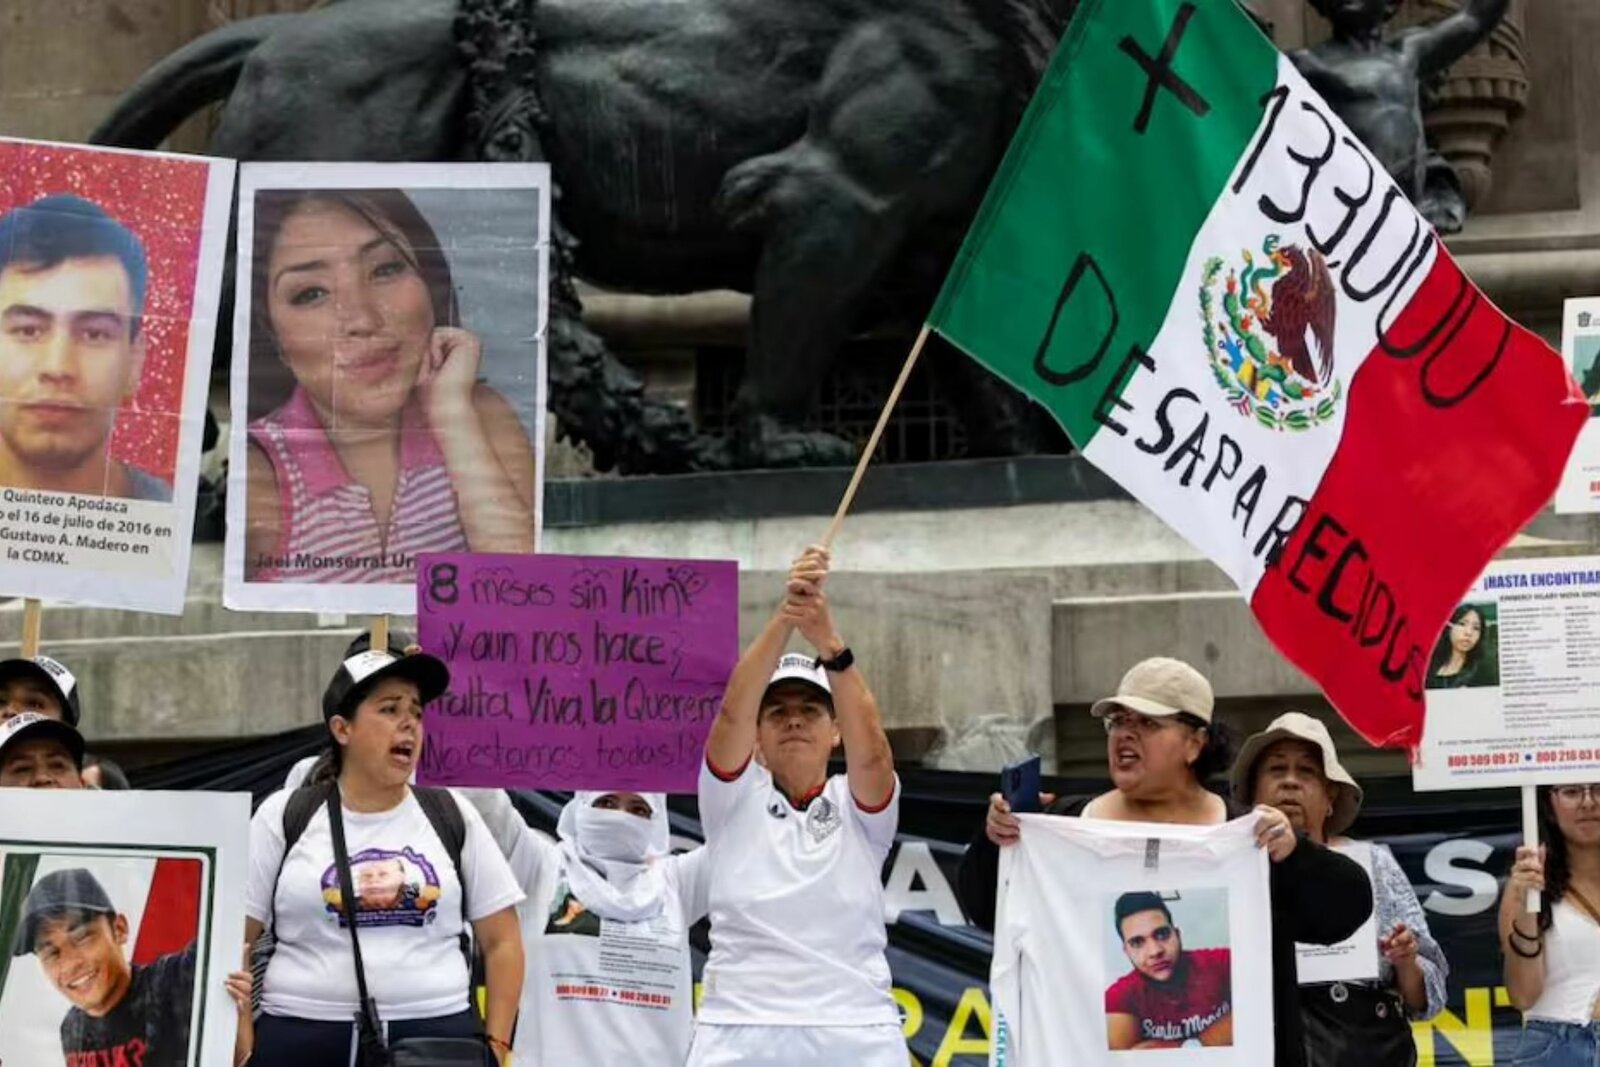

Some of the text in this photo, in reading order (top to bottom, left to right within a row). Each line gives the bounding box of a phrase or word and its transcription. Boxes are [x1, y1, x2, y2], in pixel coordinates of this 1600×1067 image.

[4, 489, 128, 514] Quintero Apodaca
[7, 508, 21, 522] el
[25, 510, 40, 524] 16
[43, 512, 61, 525] de
[62, 514, 94, 529] julio
[96, 518, 115, 531] de
[117, 520, 152, 536] 2016
[154, 526, 173, 538] en
[0, 526, 150, 555] Gustavo A. Madero en
[7, 546, 70, 565] la CDMX.
[294, 553, 388, 570] Monserrat
[429, 562, 459, 605] 8
[471, 578, 555, 607] meses
[569, 578, 607, 610] sin
[470, 630, 519, 663] aun
[532, 630, 582, 666] nos
